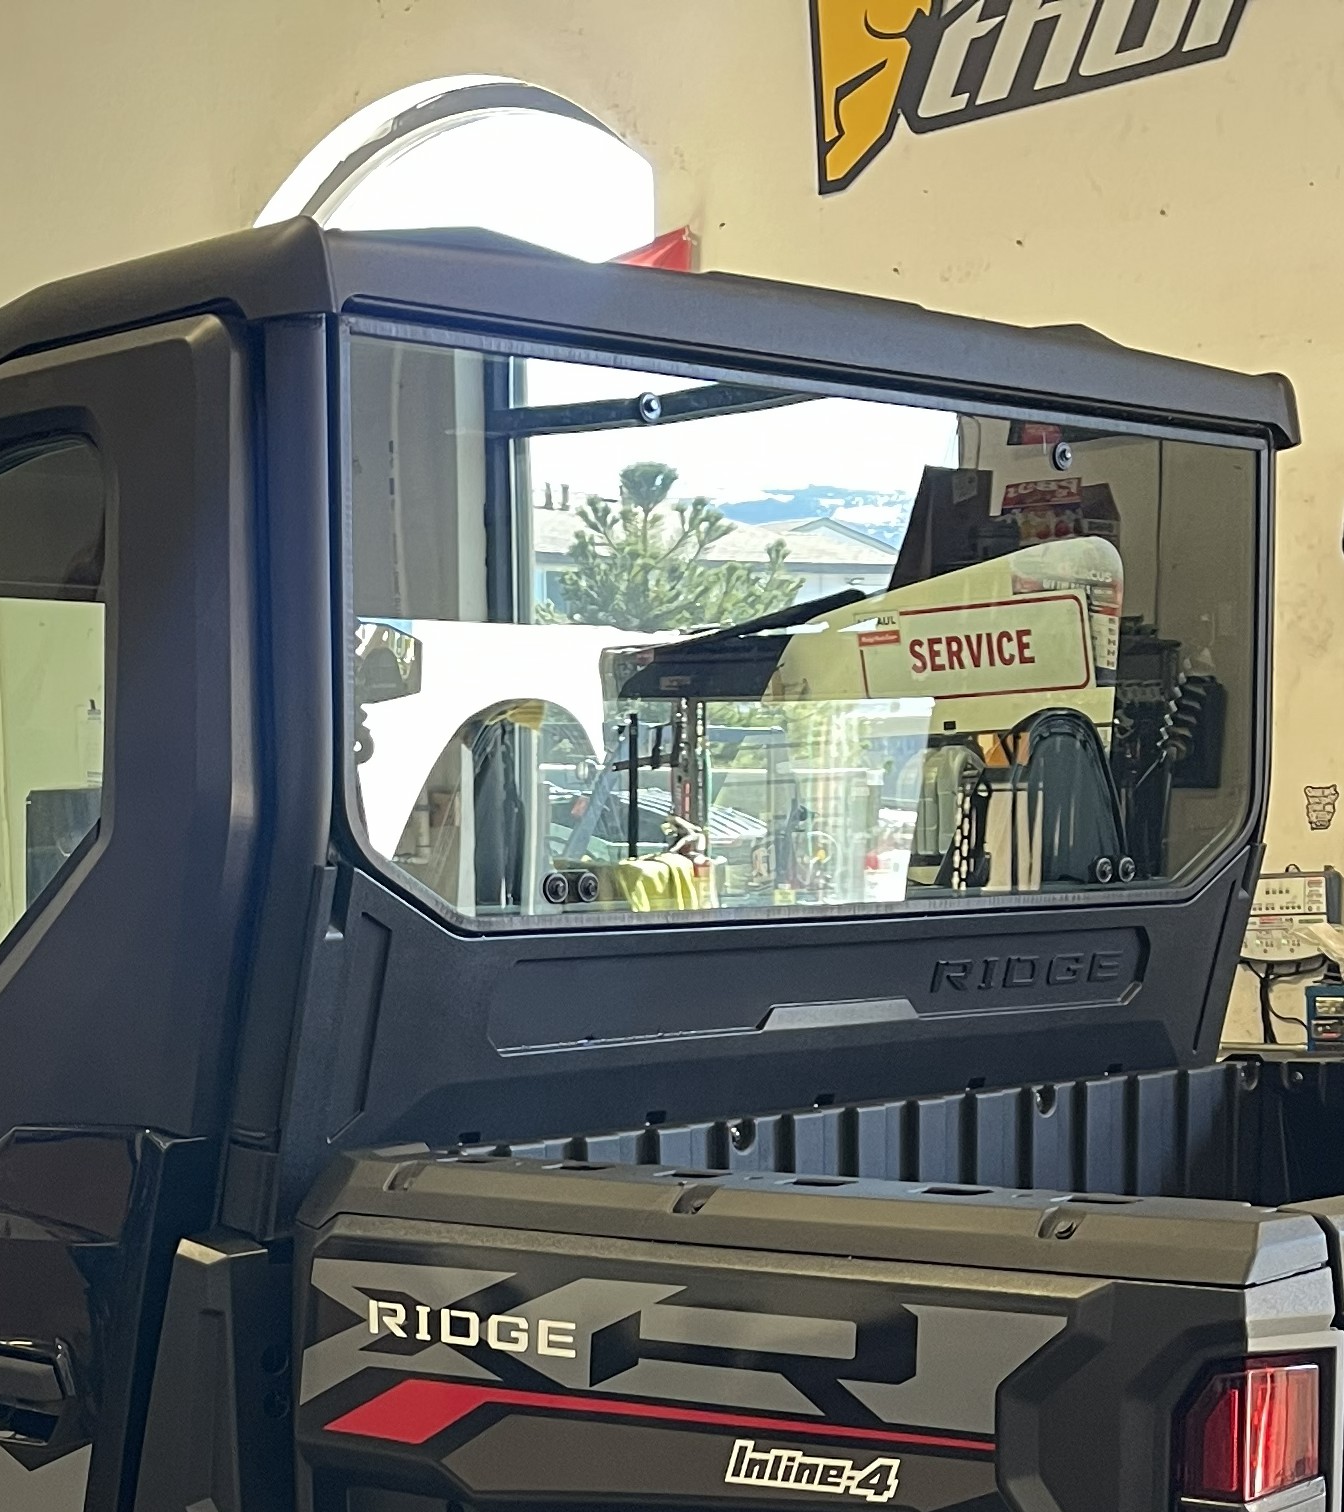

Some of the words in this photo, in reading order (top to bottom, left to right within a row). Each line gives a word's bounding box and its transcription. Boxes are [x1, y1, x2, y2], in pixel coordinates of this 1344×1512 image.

[909, 629, 1036, 674] SERVICE
[930, 951, 1124, 993] RIDGE
[368, 1299, 577, 1359] RIDGE
[724, 1438, 901, 1503] Inline-4
